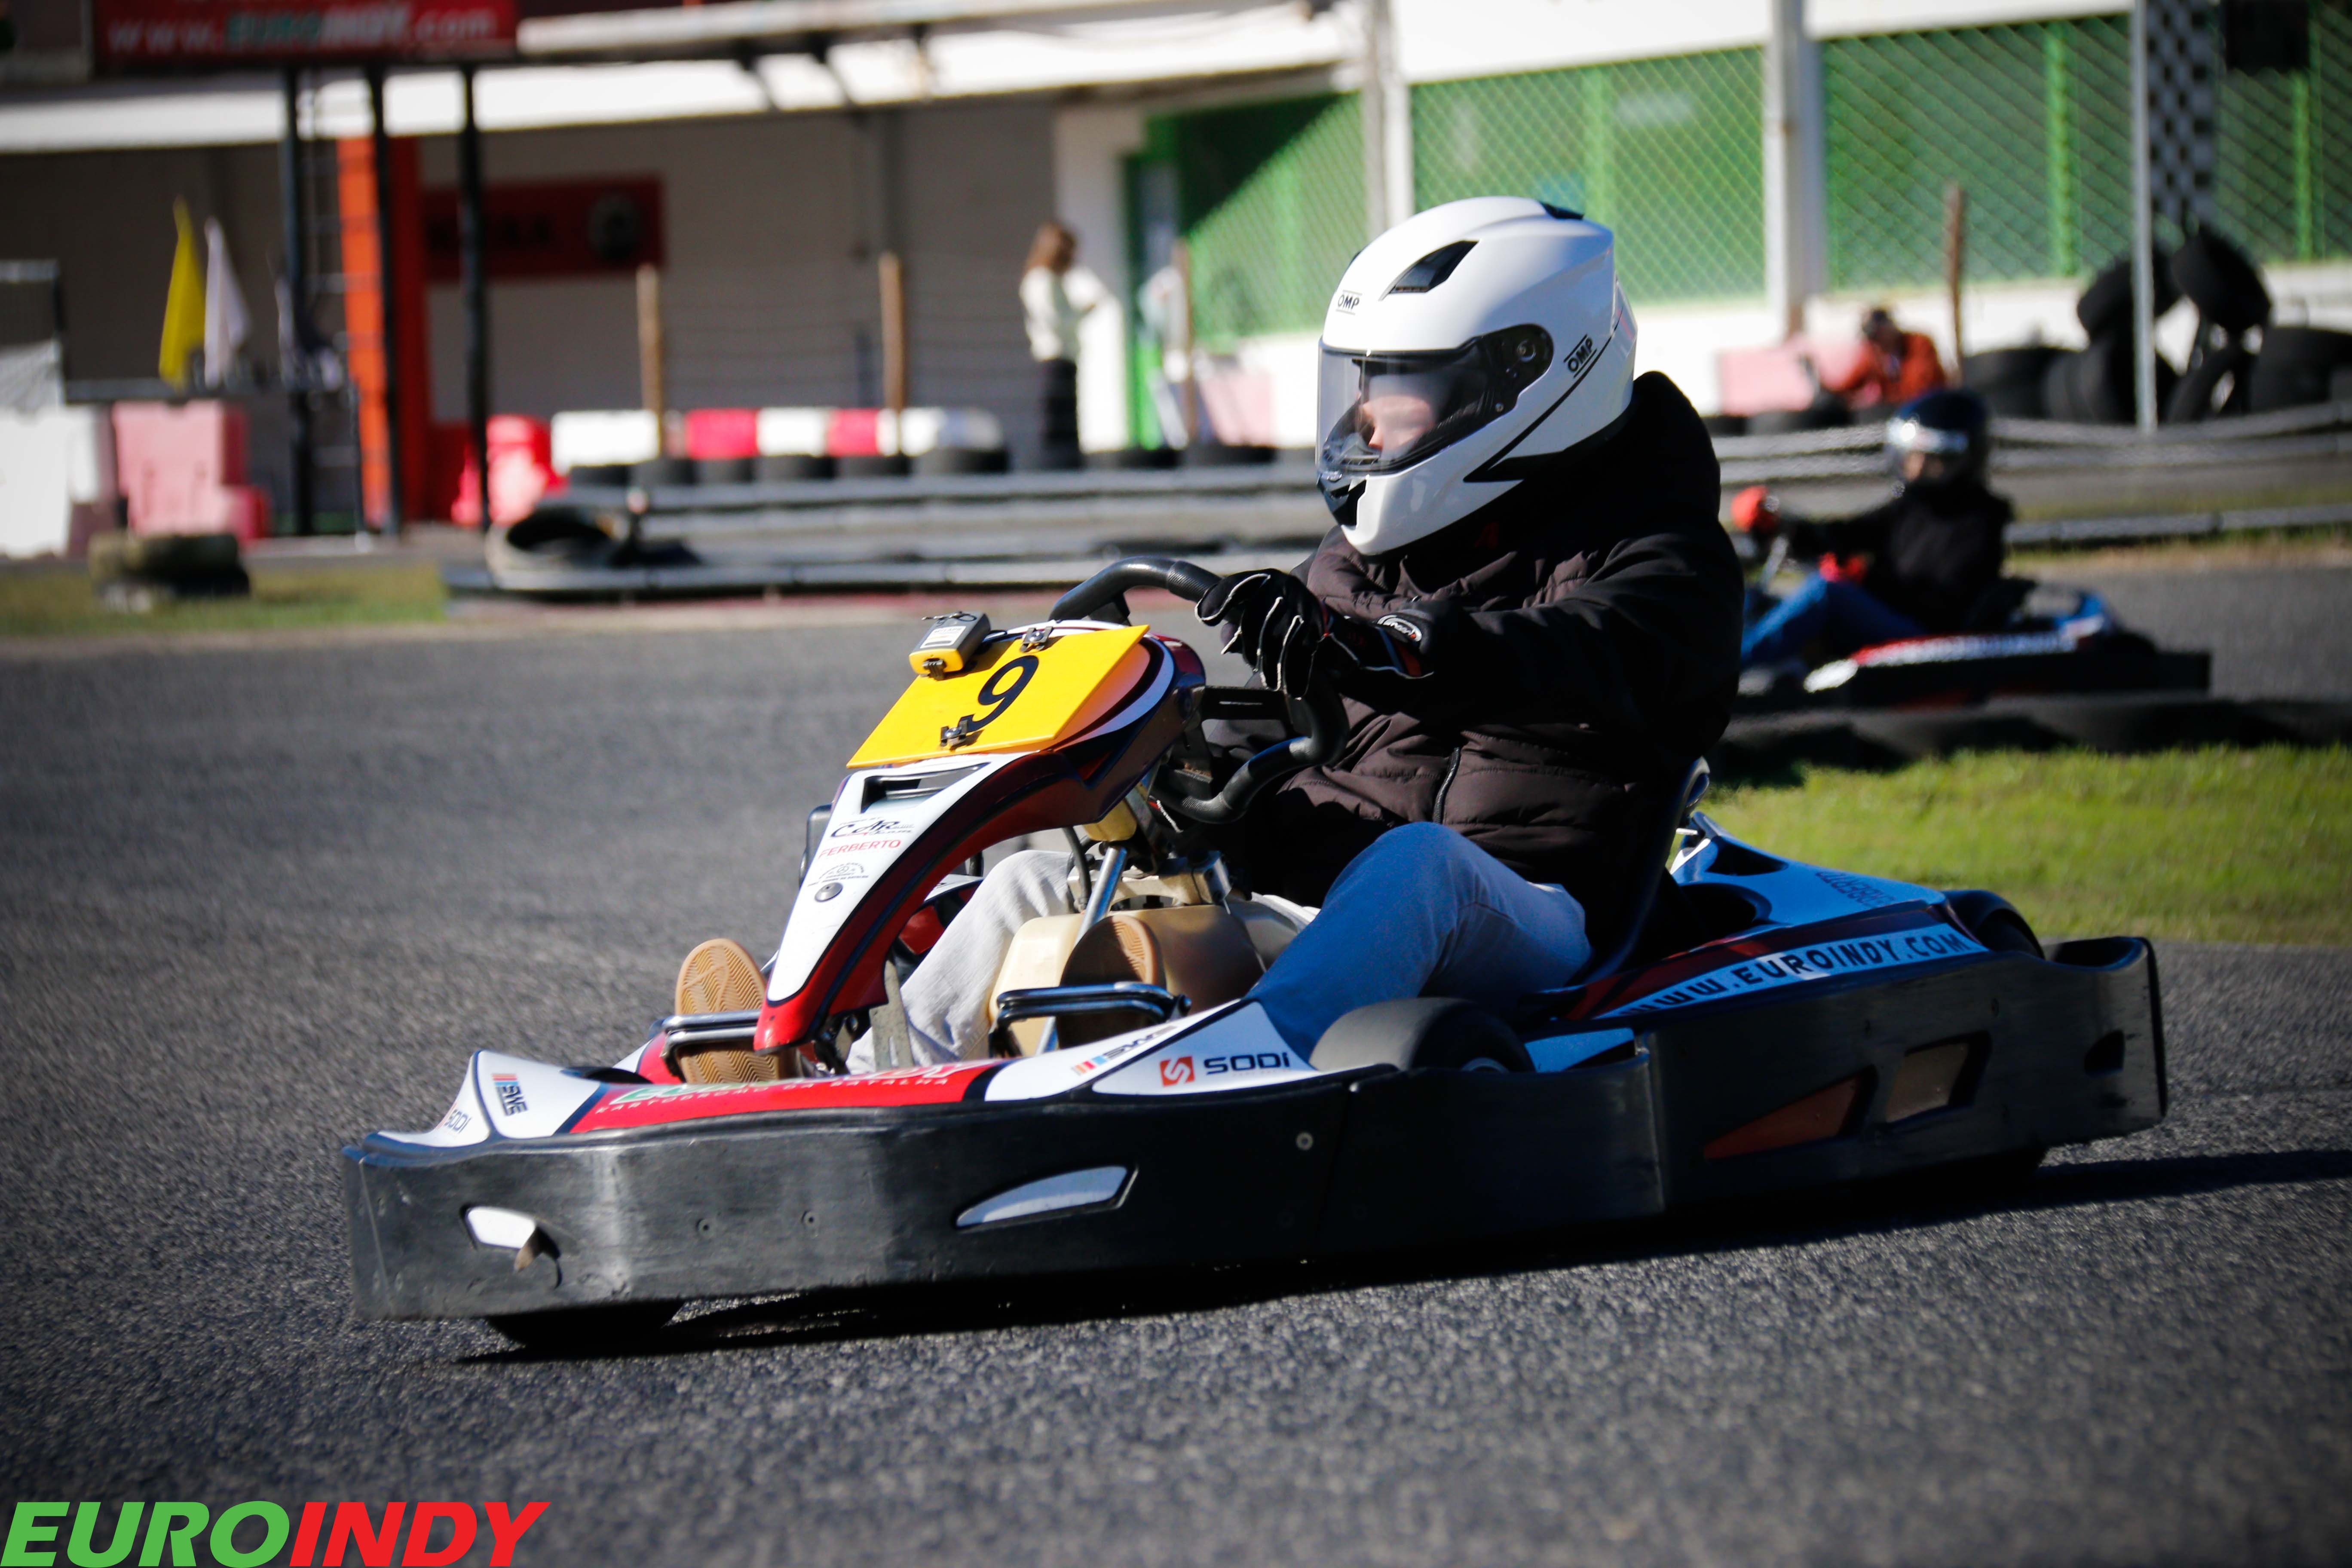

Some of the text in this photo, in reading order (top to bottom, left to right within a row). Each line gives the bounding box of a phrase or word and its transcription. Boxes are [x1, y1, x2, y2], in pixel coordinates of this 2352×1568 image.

[1338, 294, 1360, 309] OMP
[1567, 337, 1593, 373] OMP
[957, 655, 1039, 733] 9
[818, 839, 901, 860] FERBERTO
[1204, 1052, 1290, 1075] SODI
[444, 1109, 472, 1133] SODI
